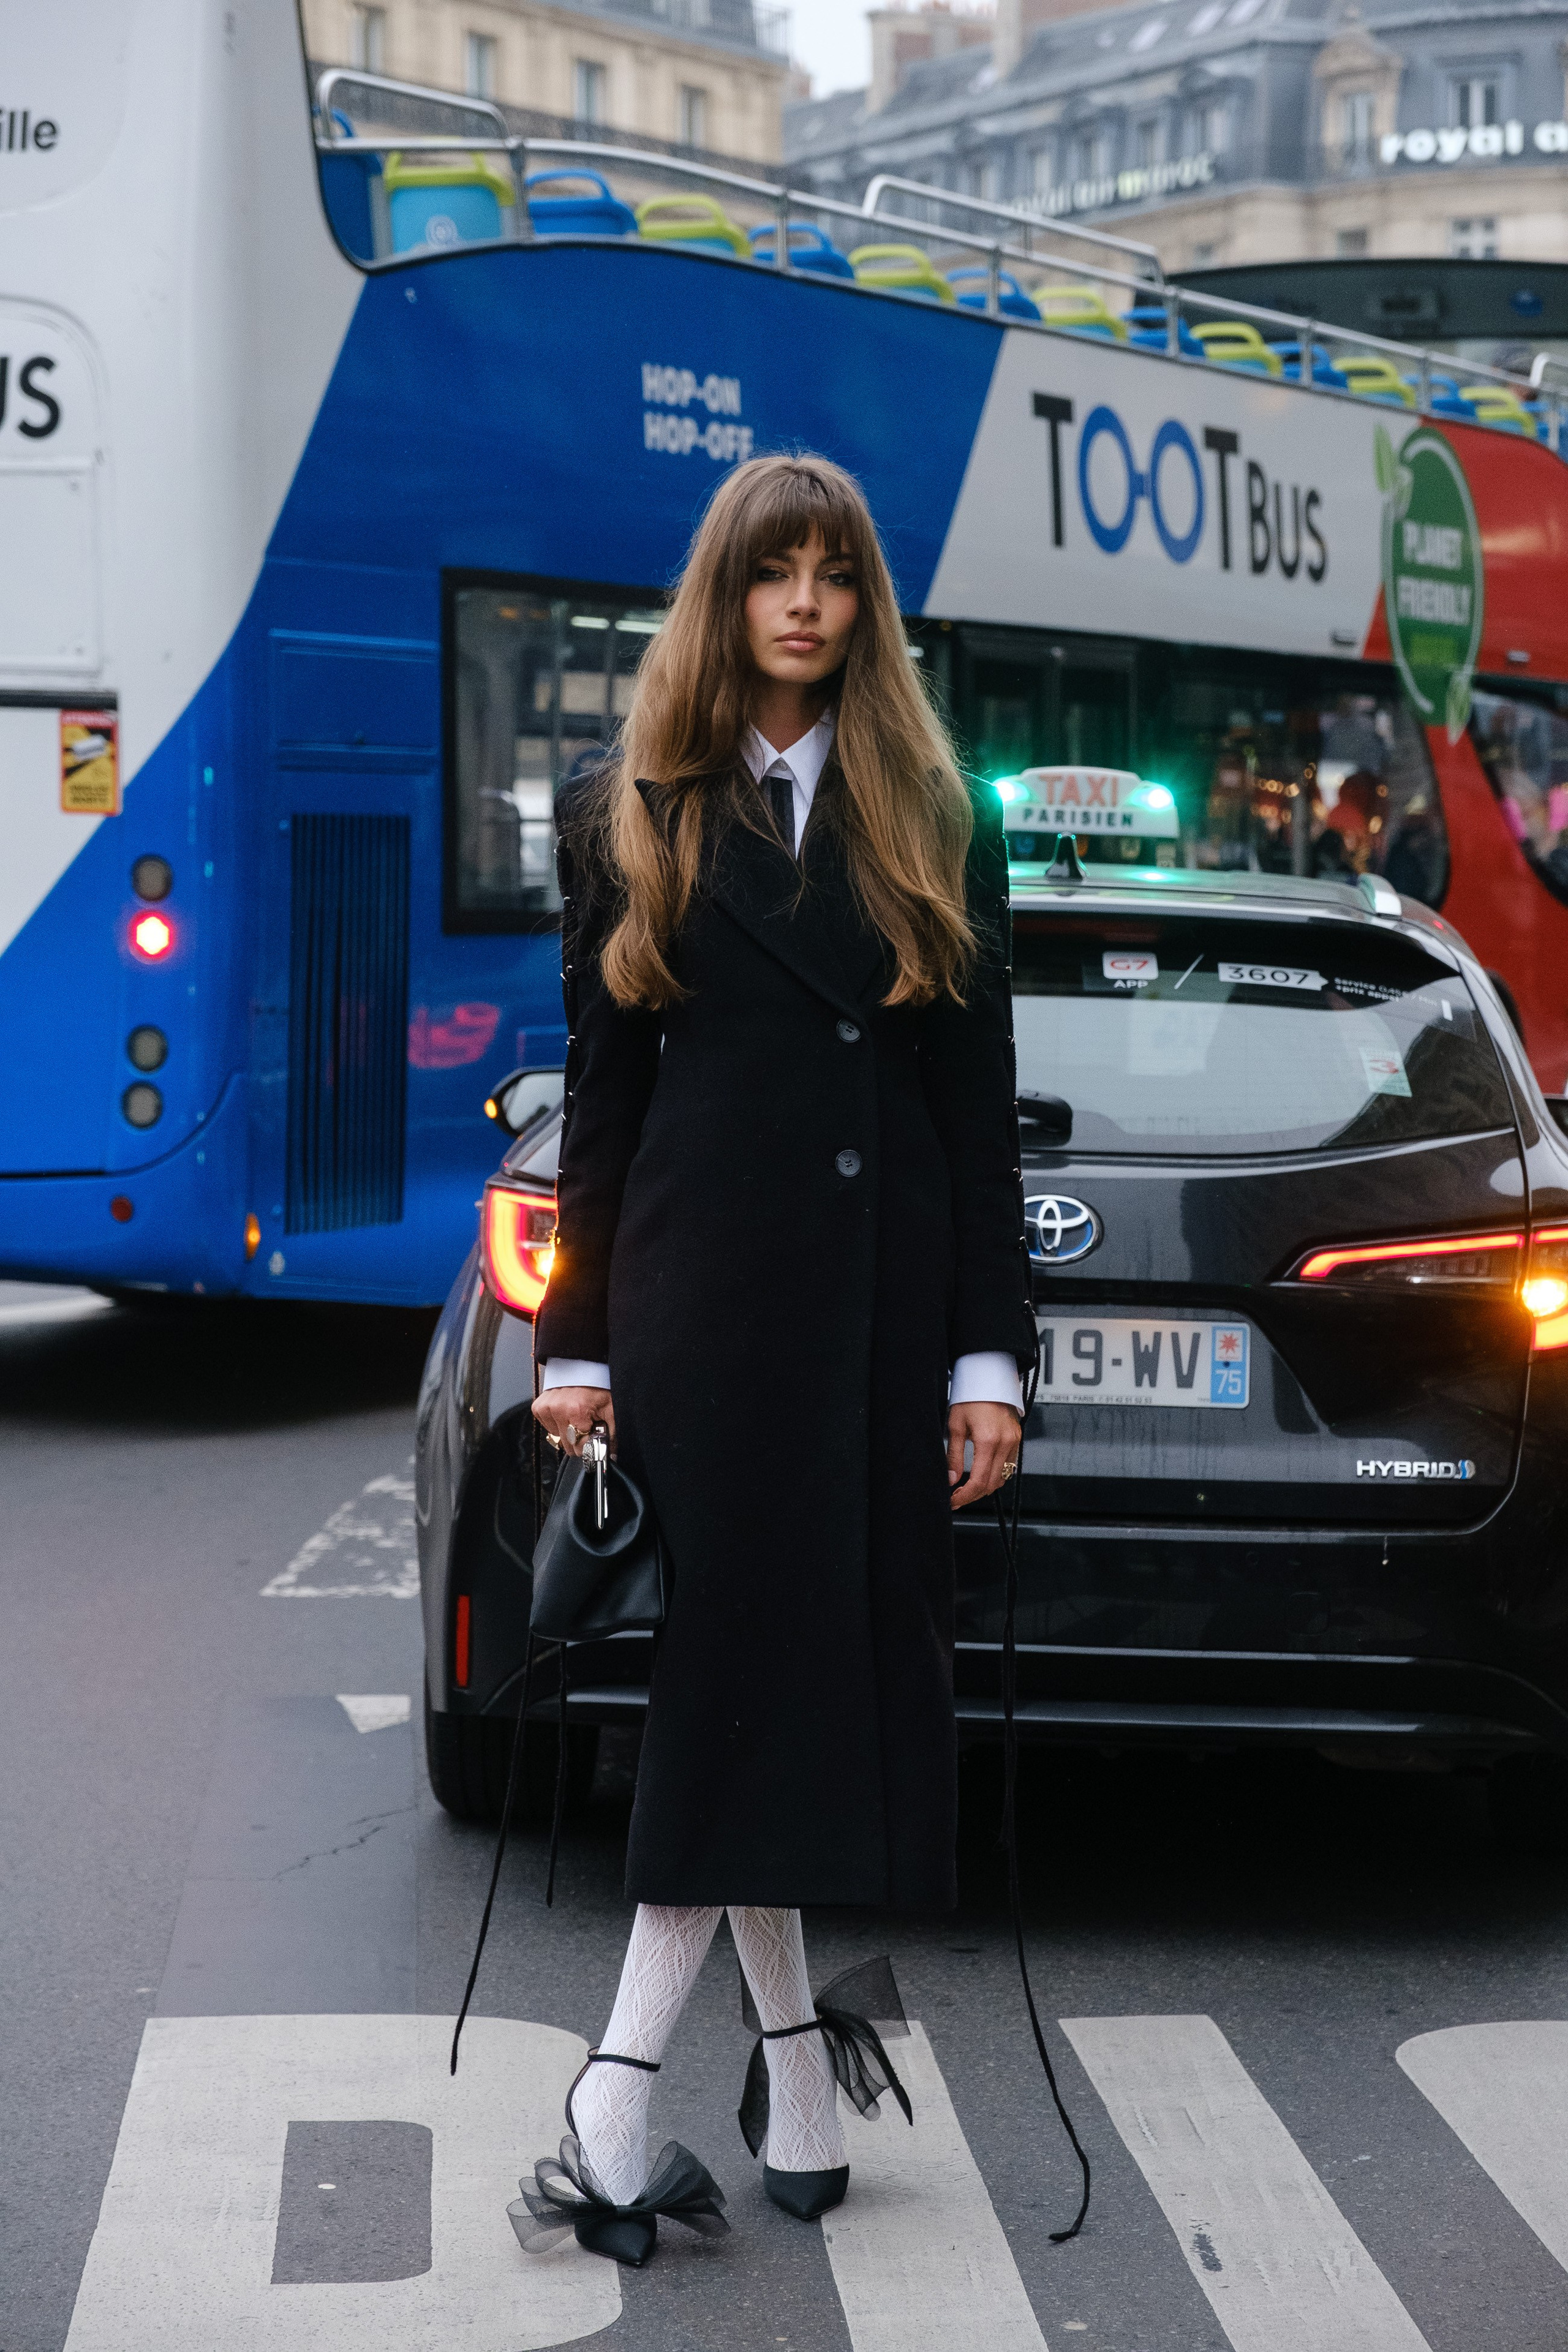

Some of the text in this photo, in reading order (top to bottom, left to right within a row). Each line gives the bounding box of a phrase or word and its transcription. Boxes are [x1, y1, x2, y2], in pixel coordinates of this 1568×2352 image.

[1381, 121, 1525, 164] royal
[0, 356, 59, 439] S
[643, 363, 741, 415] HOP-ON
[644, 412, 753, 462] HOP-OFF
[1039, 773, 1119, 807] TAXI
[1022, 809, 1133, 827] PARISIEN
[1110, 959, 1148, 970] G7
[1227, 965, 1309, 985] 3607
[1113, 980, 1148, 989] APP
[1334, 977, 1376, 990] Service
[1216, 1369, 1242, 1395] 75
[1356, 1460, 1457, 1478] HYBRID
